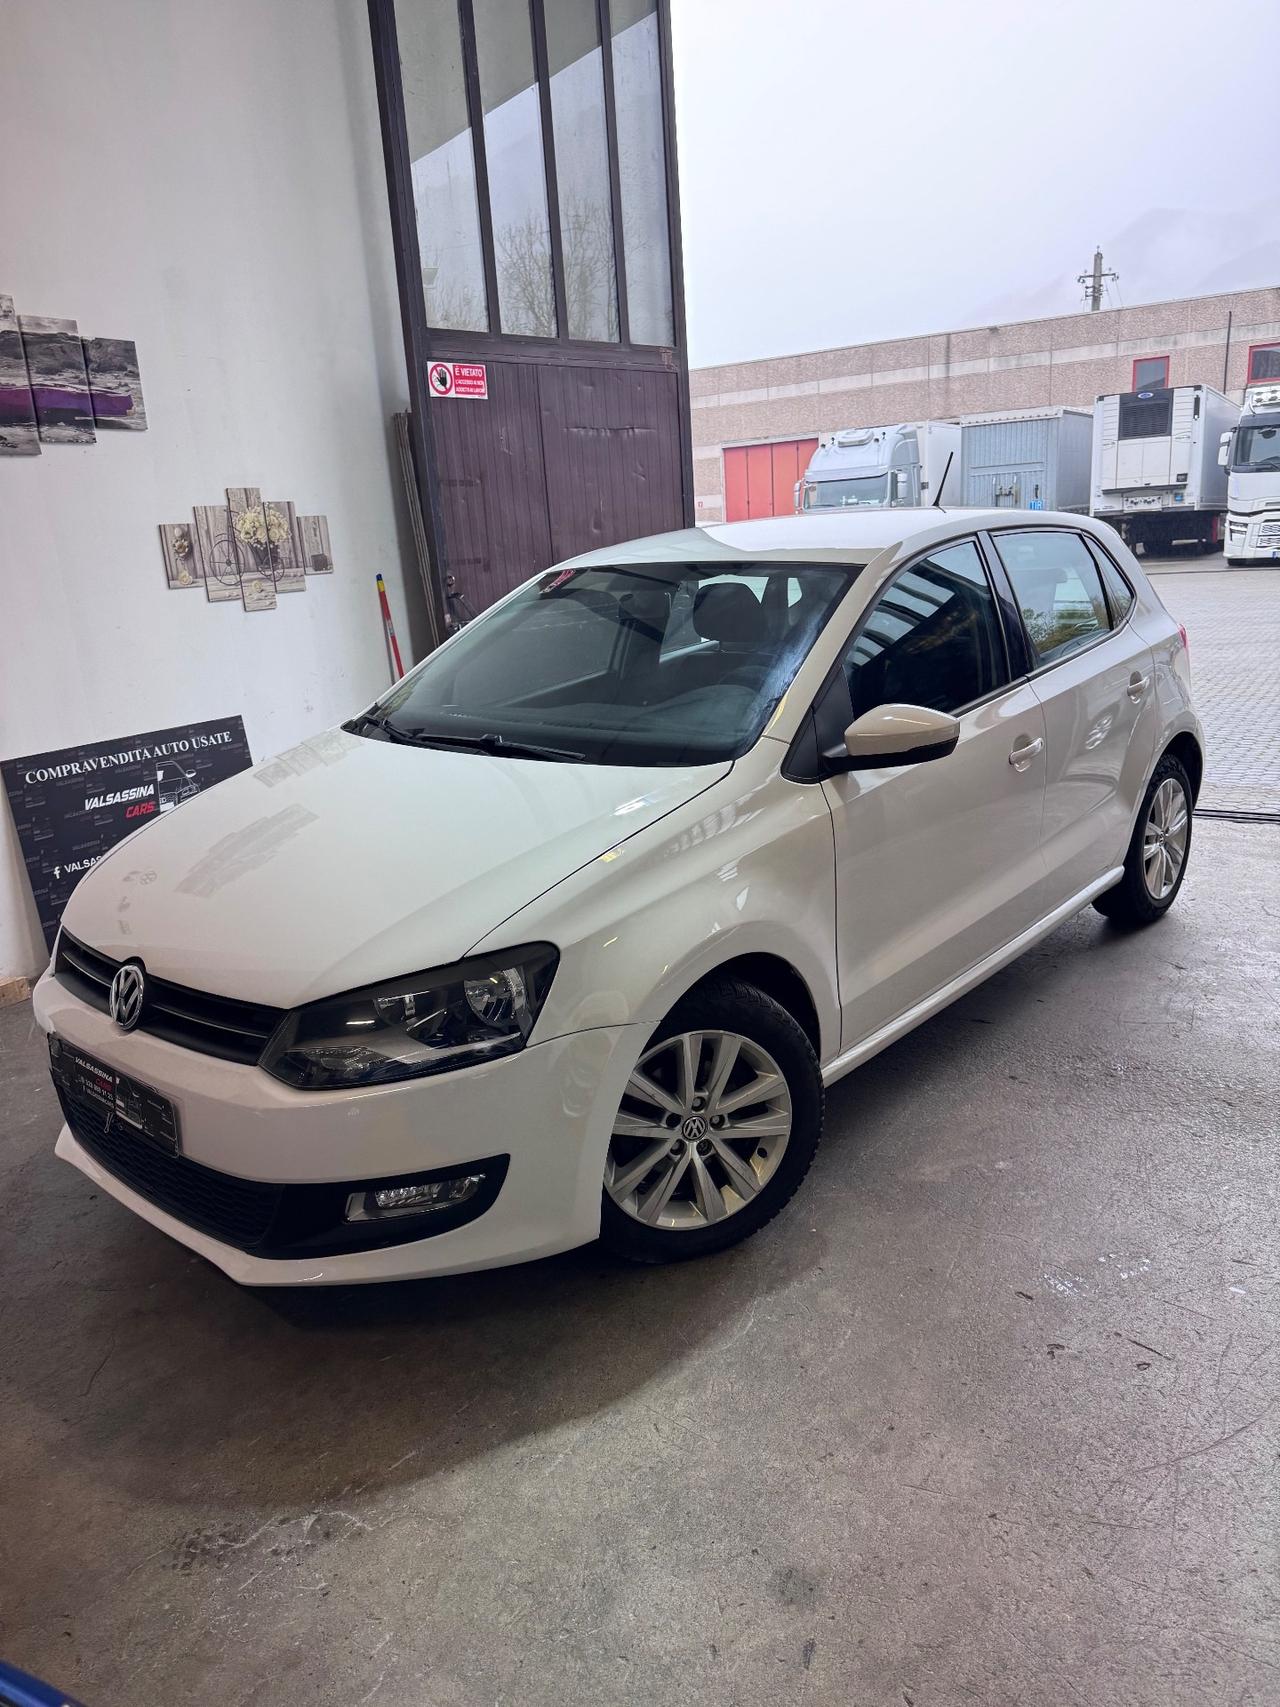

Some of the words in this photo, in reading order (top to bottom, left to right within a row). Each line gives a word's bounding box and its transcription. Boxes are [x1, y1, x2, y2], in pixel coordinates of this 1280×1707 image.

[461, 368, 483, 377] VIETATO
[25, 749, 152, 784] COMPRAVENDITA
[153, 740, 190, 758] AUTO
[191, 731, 233, 749] USATE
[84, 784, 155, 811] VALSASSINA
[125, 801, 156, 818] CARS
